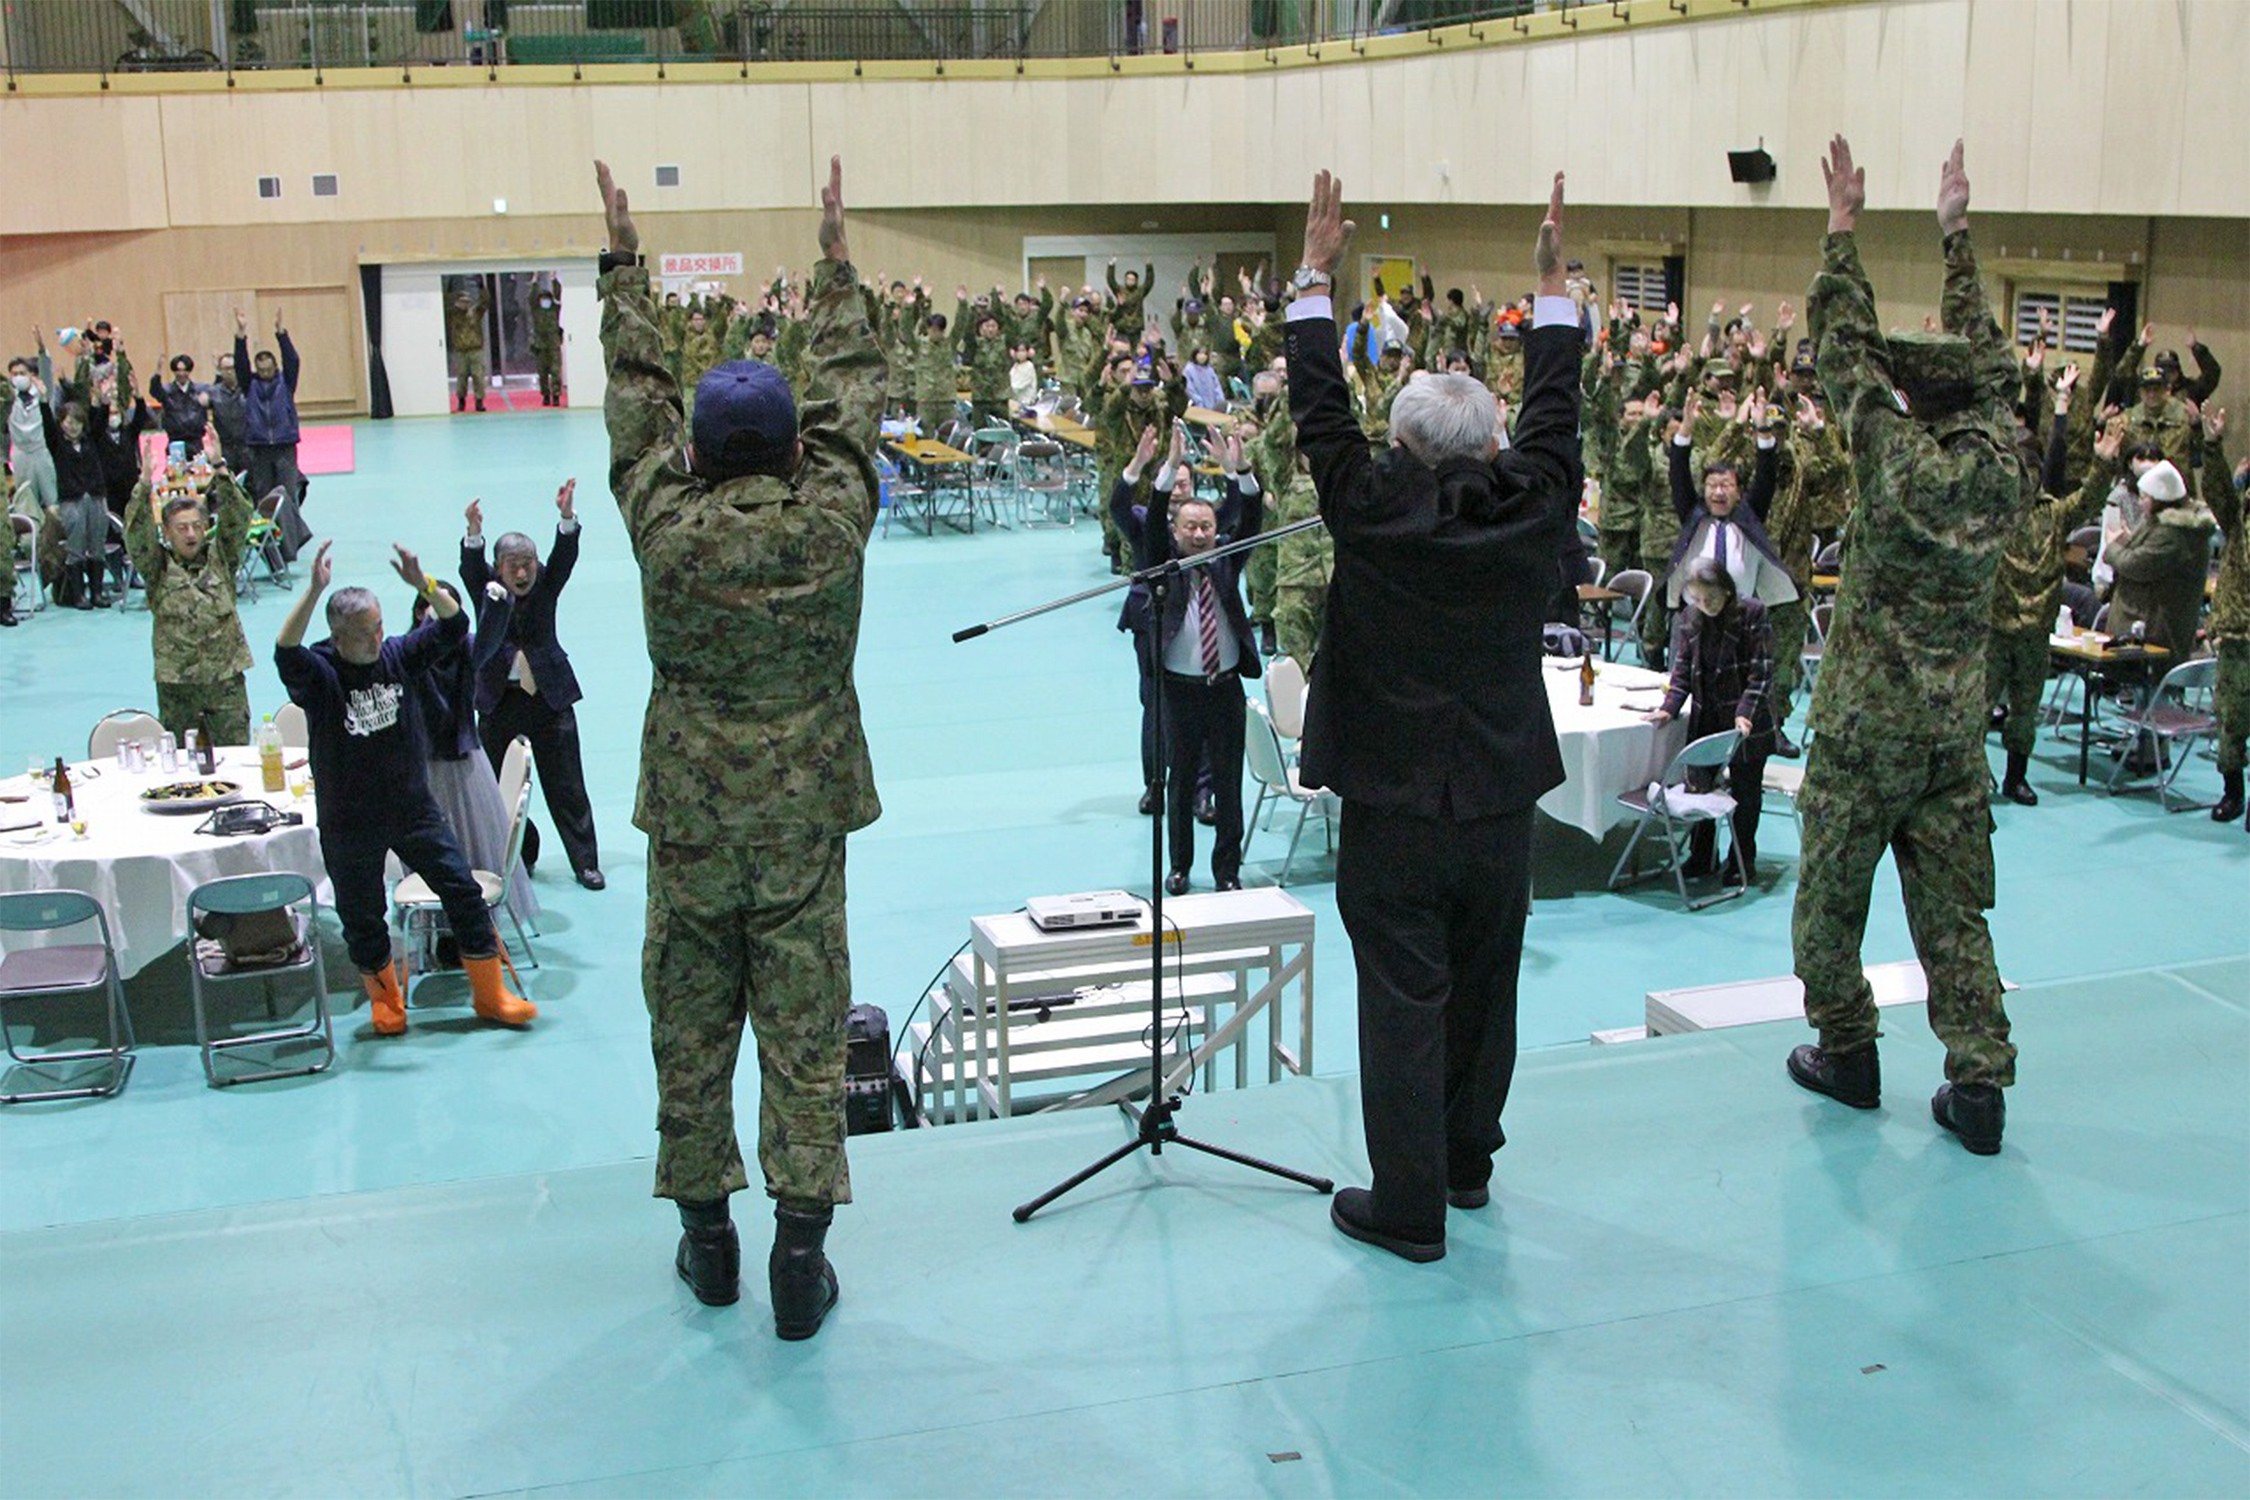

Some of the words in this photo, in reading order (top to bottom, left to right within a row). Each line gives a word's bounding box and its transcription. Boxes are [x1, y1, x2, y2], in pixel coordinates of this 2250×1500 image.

[664, 256, 736, 273] 景品交換所
